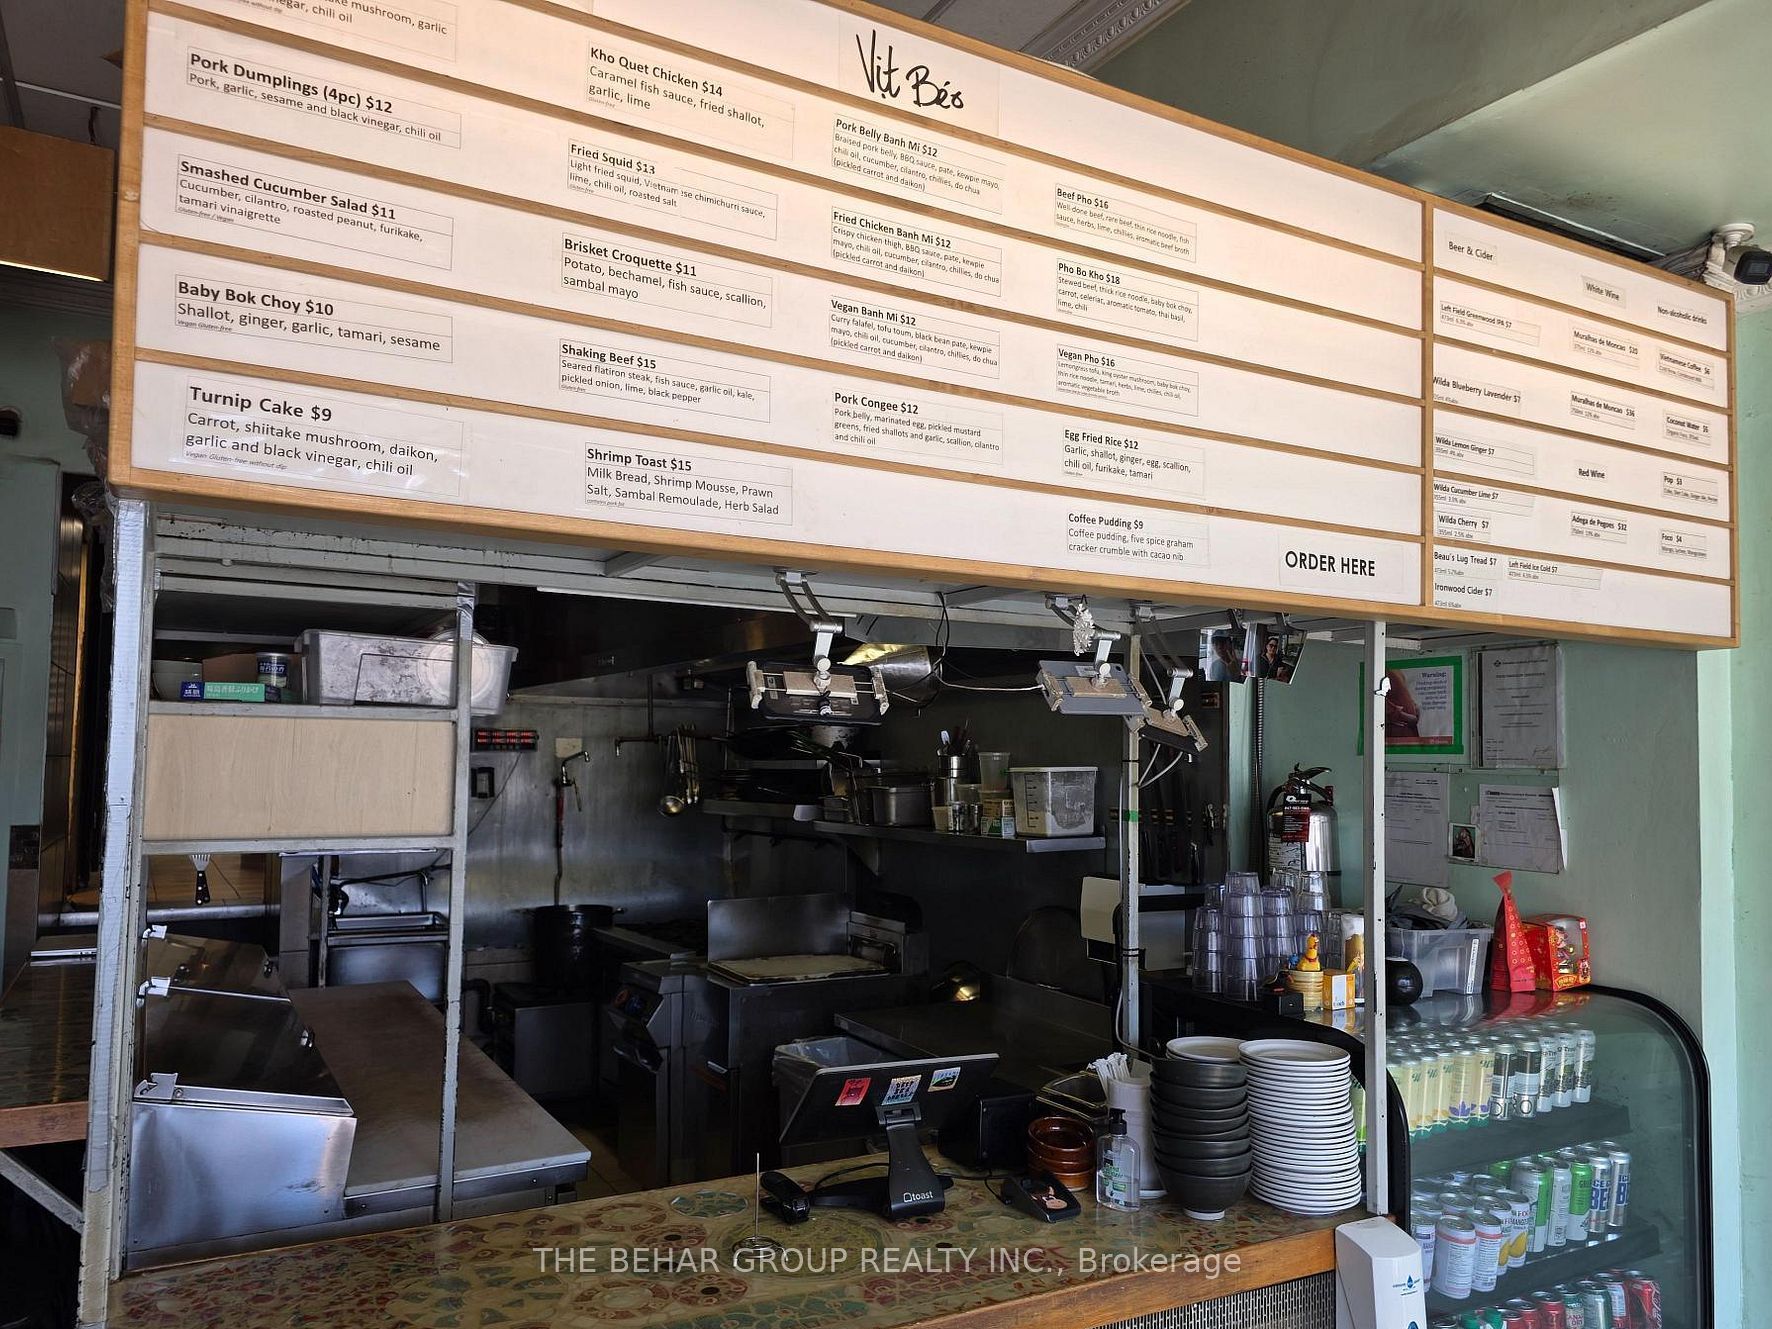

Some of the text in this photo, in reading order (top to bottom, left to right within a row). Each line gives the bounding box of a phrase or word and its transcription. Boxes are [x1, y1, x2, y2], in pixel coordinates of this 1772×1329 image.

[190, 53, 393, 113] Pork Dumplings (4pc) $12
[590, 47, 723, 96] Kho Quet Chicken $14
[188, 73, 441, 141] Pork, garlic, sesame and black vinegar, chili oil
[589, 66, 764, 127] Caramel fish sauce, fried shallot,
[835, 118, 938, 157] Pork Belly Banh Mi $12
[570, 144, 655, 174] Fried Squid $13
[180, 161, 396, 219] Smashed Cucumber Salad $11
[1056, 188, 1109, 209] Beef Pho $16
[833, 211, 951, 248] Fried Chicken Banh Mi $12
[564, 238, 697, 276] Brisket Croquette $11
[1448, 241, 1493, 260] Beer & Cider
[1058, 262, 1120, 284] Pho Bo Kho $18
[178, 281, 334, 315] Baby Bok Choy $10
[1585, 283, 1620, 300] White Wine
[831, 300, 916, 326] Vegan Banh Mi $12
[561, 344, 656, 369] Shaking Beef $15
[1058, 348, 1116, 367] Vegan Pho $16
[834, 392, 919, 414] Pork Congee $12
[1451, 380, 1482, 396] Blueberry
[1483, 389, 1512, 401] Lavender
[1513, 395, 1521, 403] $7
[189, 386, 332, 421] Turnip Cake $9
[187, 412, 438, 462] Carrot, shiitake mushroom, daikon,
[1064, 429, 1139, 450] Egg Fried Rice $12
[1435, 436, 1495, 457] Wilda Lemon Ginger $7
[586, 448, 692, 471] Shrimp Toast $15
[587, 467, 773, 498] Milk Bread, Shrimp Mousse, Prawn
[1578, 468, 1605, 478] Red Wine
[1433, 483, 1450, 492] Wilda
[1450, 486, 1478, 496] Cucumber
[1478, 490, 1491, 498] Lime
[1068, 513, 1144, 530] Coffee Pudding $9
[1438, 515, 1489, 529] Wilda Cherry $7
[1068, 543, 1186, 561] cracker crumble with cacao nib
[1285, 551, 1375, 576] ORDER HERE
[1433, 551, 1497, 565] Beau's Lug Tread $7
[1434, 583, 1493, 596] Ironwood Cider $7
[911, 1190, 934, 1202] toast
